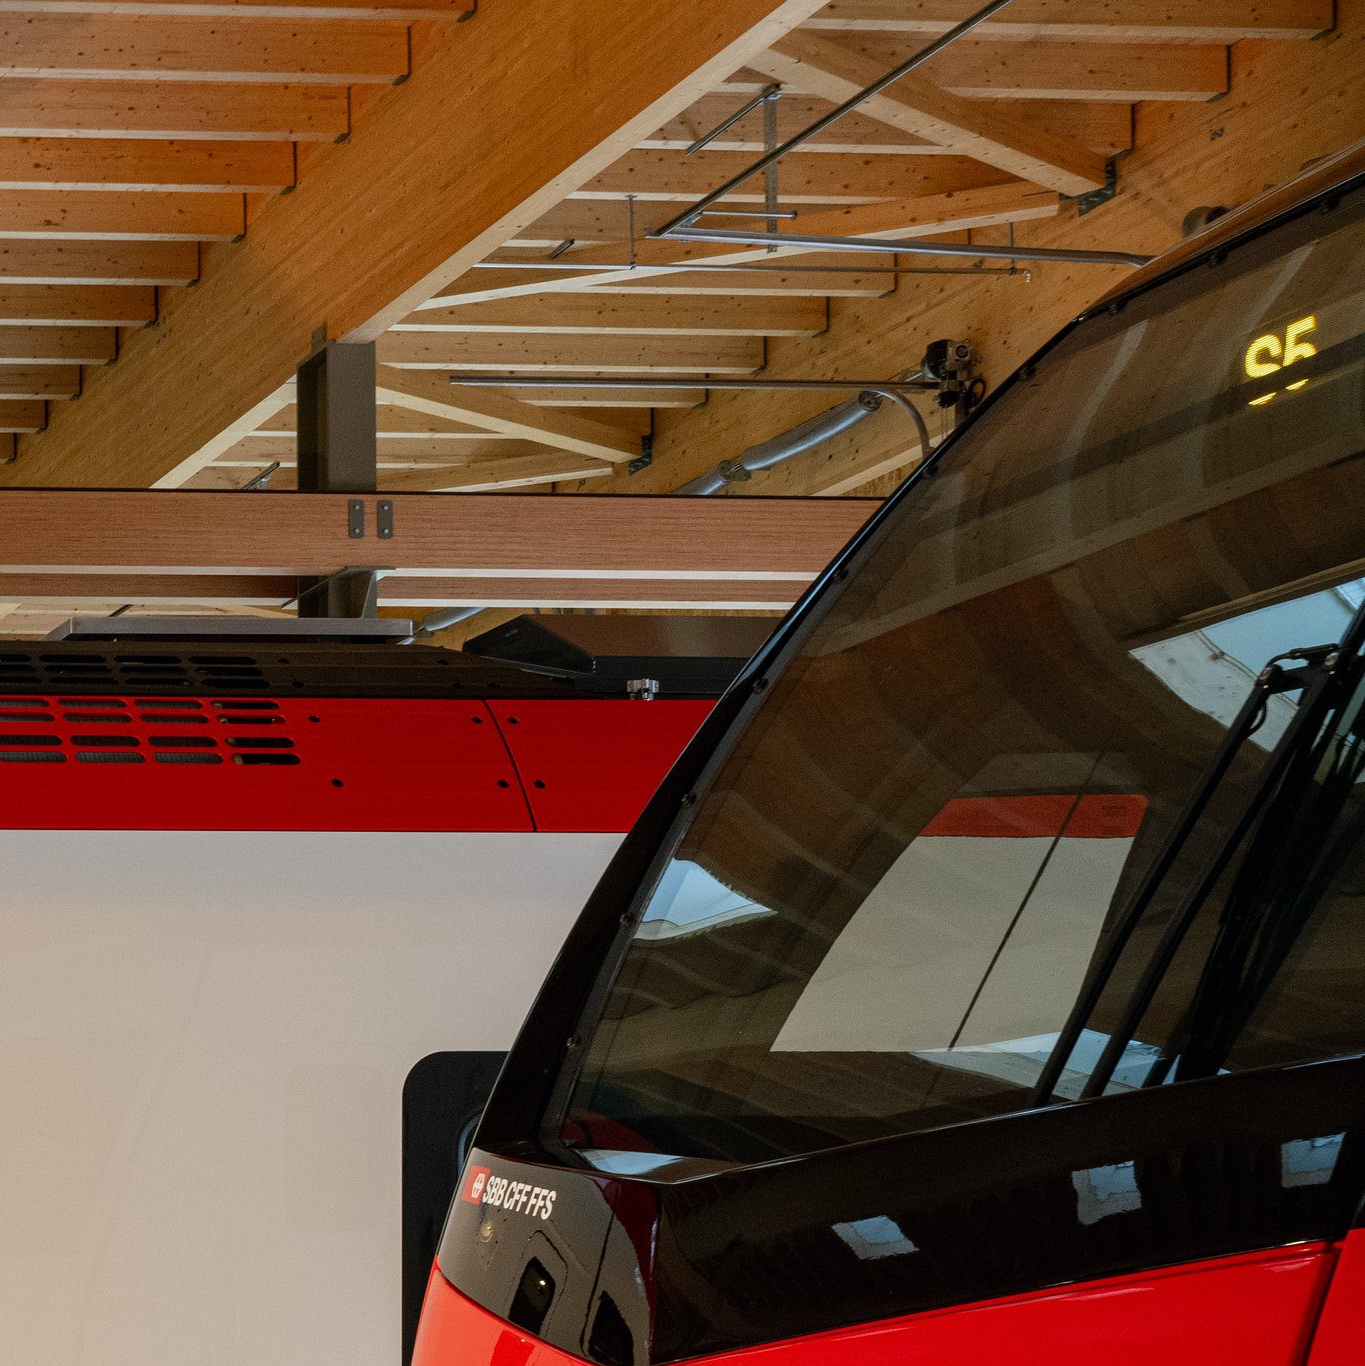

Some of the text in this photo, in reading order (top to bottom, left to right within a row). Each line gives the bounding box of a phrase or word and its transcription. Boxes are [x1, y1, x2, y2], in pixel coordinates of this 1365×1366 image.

[482, 1175, 557, 1220] SBB CFF FFS
